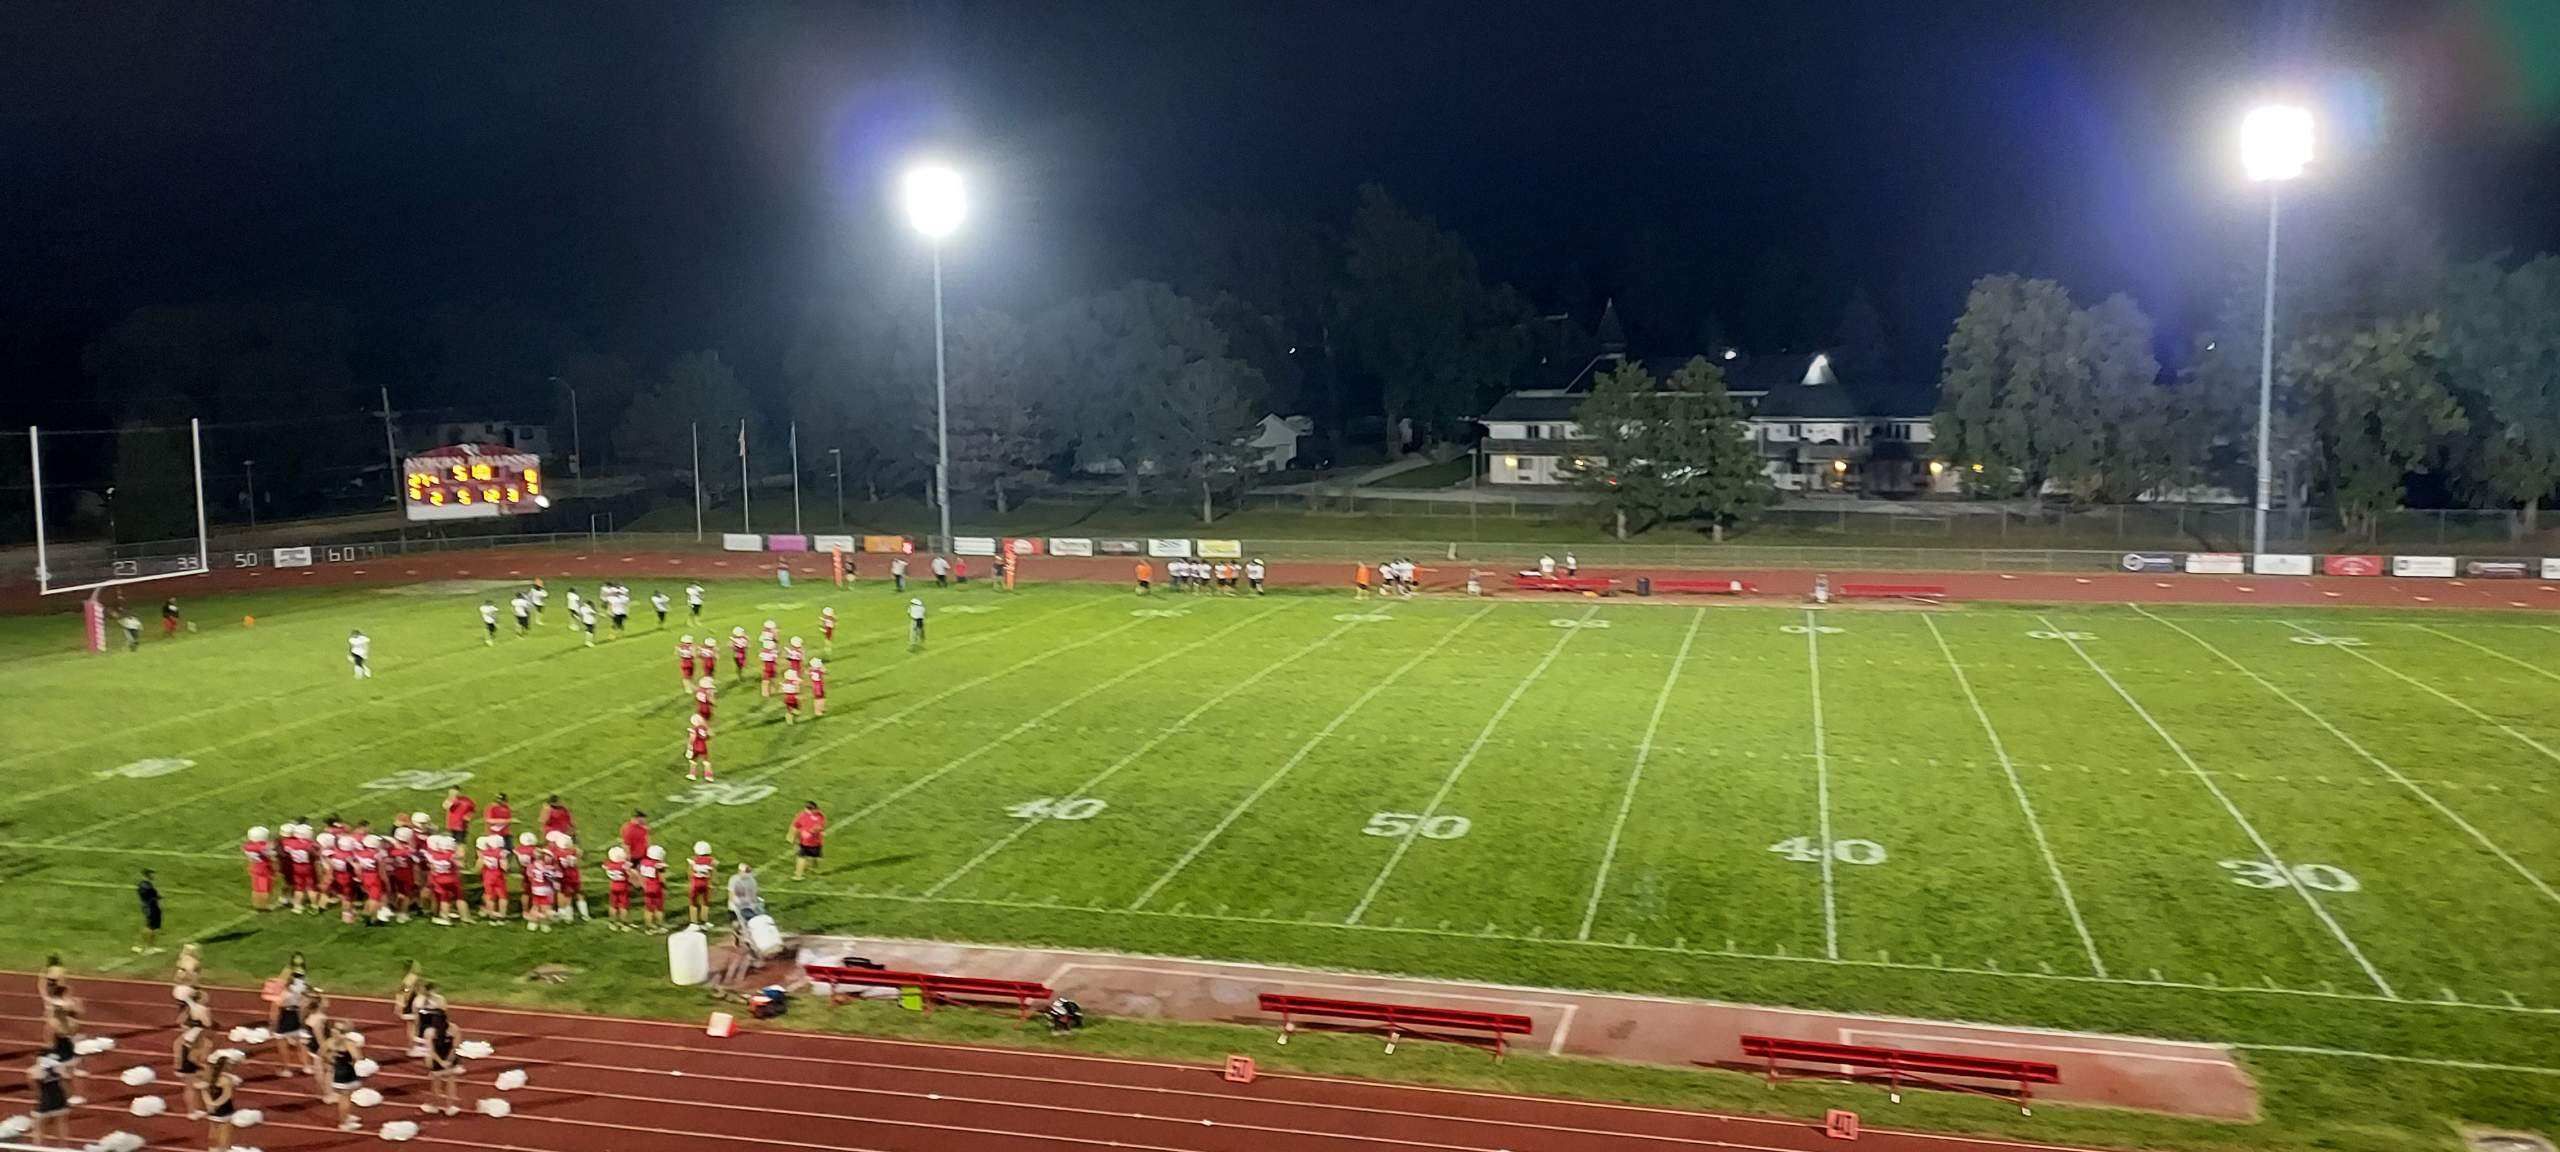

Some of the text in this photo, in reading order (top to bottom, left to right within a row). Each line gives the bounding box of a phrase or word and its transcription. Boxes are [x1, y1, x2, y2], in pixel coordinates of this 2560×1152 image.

[235, 553, 258, 568] 50
[329, 547, 354, 562] 60
[1001, 798, 1108, 820] 40
[1361, 812, 1471, 840] 50
[1766, 836, 1887, 865] 40
[2215, 860, 2361, 892] 30
